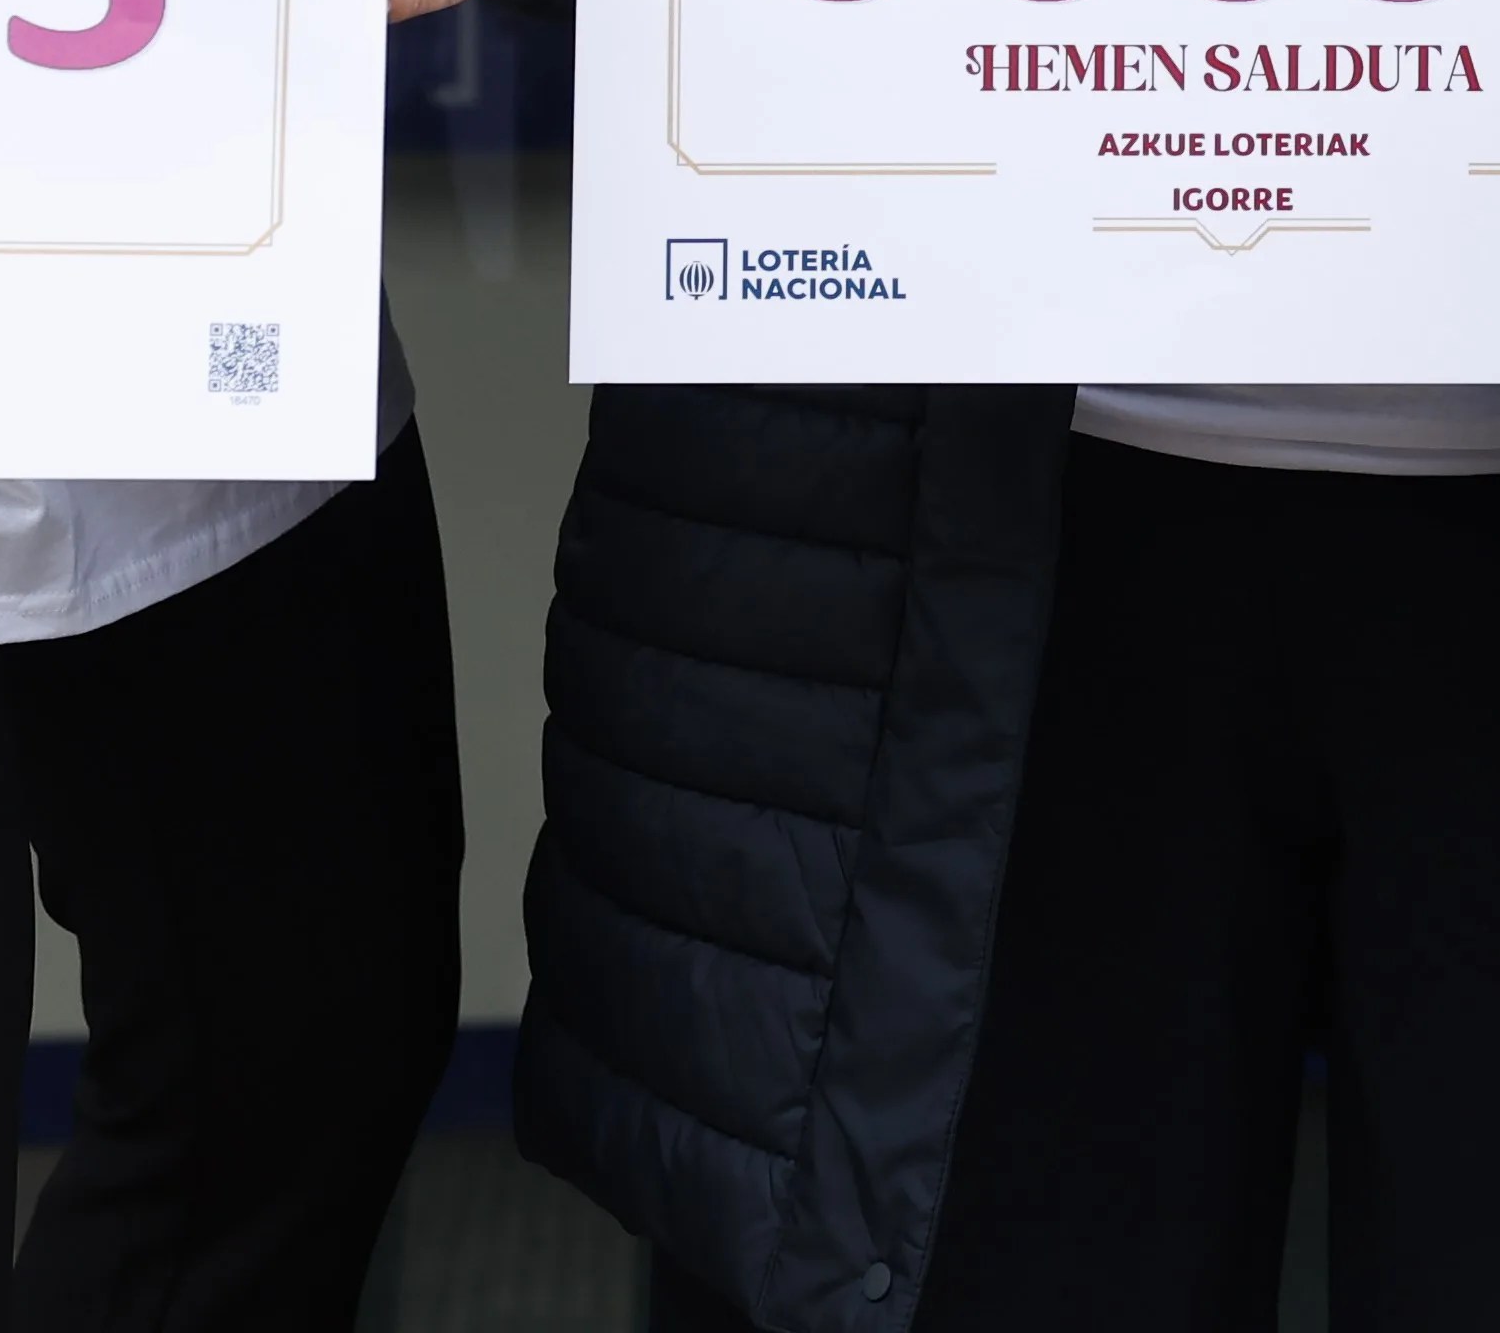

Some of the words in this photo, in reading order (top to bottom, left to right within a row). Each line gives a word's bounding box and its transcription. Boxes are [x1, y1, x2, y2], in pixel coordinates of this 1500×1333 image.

[965, 44, 1189, 93] HEMEN
[1203, 43, 1484, 93] SALDUTA
[1097, 132, 1206, 157] AZKUE
[1214, 132, 1371, 157] LOTERIAK
[1173, 187, 1294, 212] IGORRE
[742, 243, 873, 272] LOTERÍA
[741, 277, 907, 301] NACIONAL
